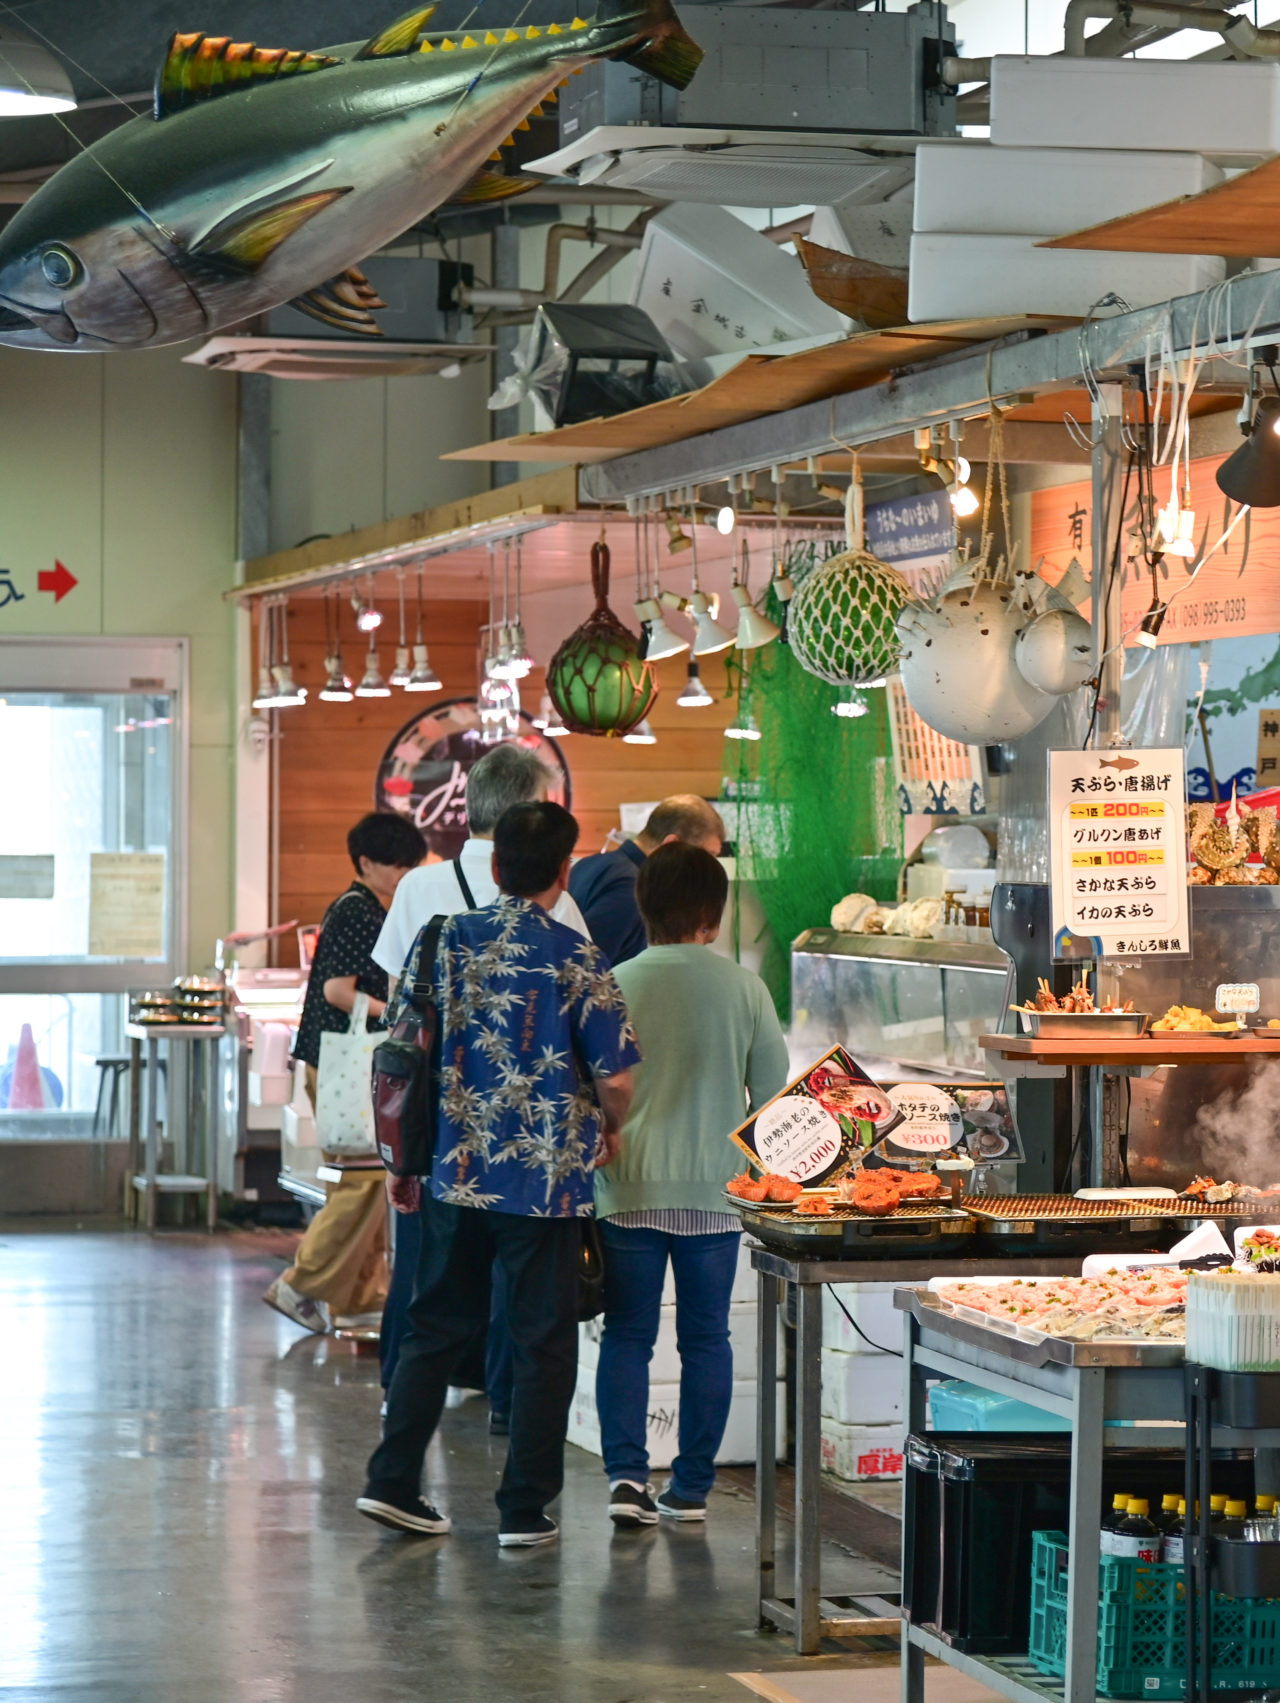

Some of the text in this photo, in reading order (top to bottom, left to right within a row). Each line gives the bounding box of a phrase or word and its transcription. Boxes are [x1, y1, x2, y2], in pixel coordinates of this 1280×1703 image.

[1260, 720, 1280, 775] 神戸
[1070, 774, 1172, 793] 天ぷら・唐揚げ
[1073, 827, 1162, 843] グルクン唐あげ
[1075, 875, 1157, 892] さかな天ぷら
[1077, 903, 1154, 920] イカの天ぷら
[1116, 938, 1182, 952] きんしろ鮮魚
[897, 1101, 940, 1112] ホタテの
[763, 1105, 811, 1149] 伊勢海老の
[764, 1109, 829, 1164] ウニソース焼き
[901, 1133, 948, 1146] ¥300
[790, 1138, 837, 1181] ¥2,000
[857, 1453, 903, 1476] 厚岸
